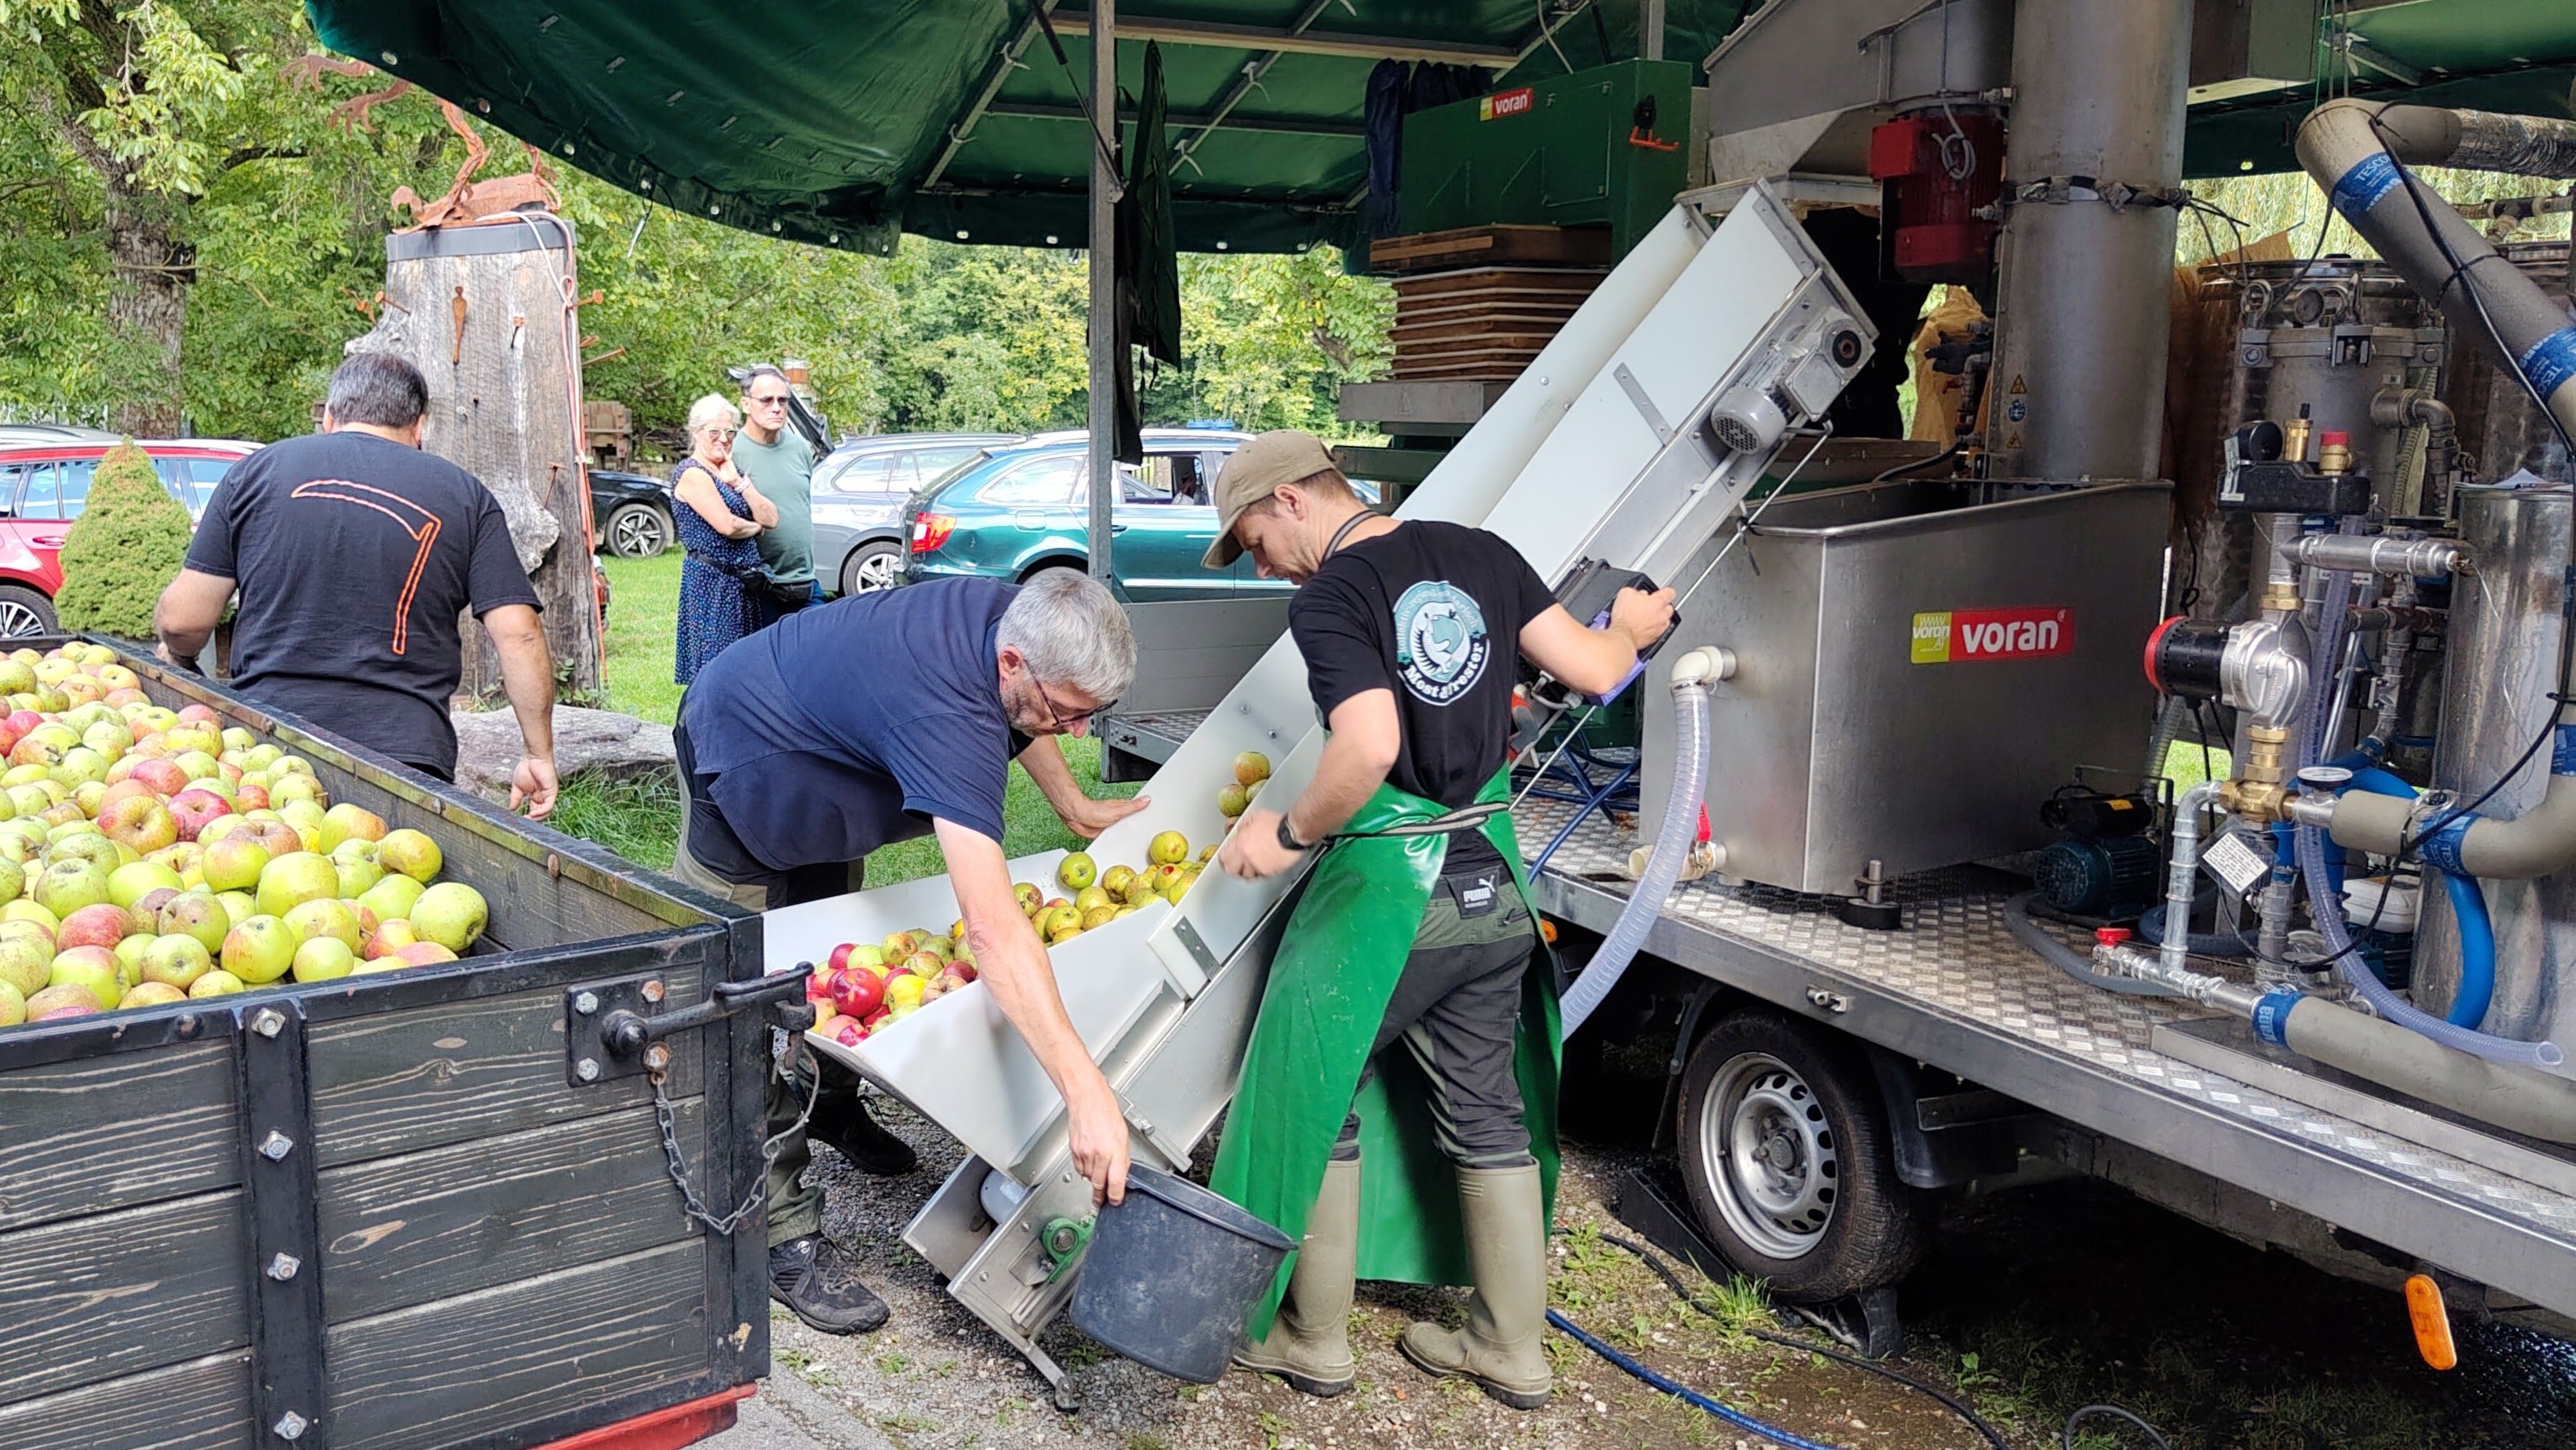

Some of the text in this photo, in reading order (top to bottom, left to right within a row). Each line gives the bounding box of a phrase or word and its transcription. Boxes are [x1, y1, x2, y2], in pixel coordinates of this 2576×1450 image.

[1495, 94, 1527, 115] voran
[1962, 621, 2059, 654] voran
[1404, 665, 1440, 698] Most
